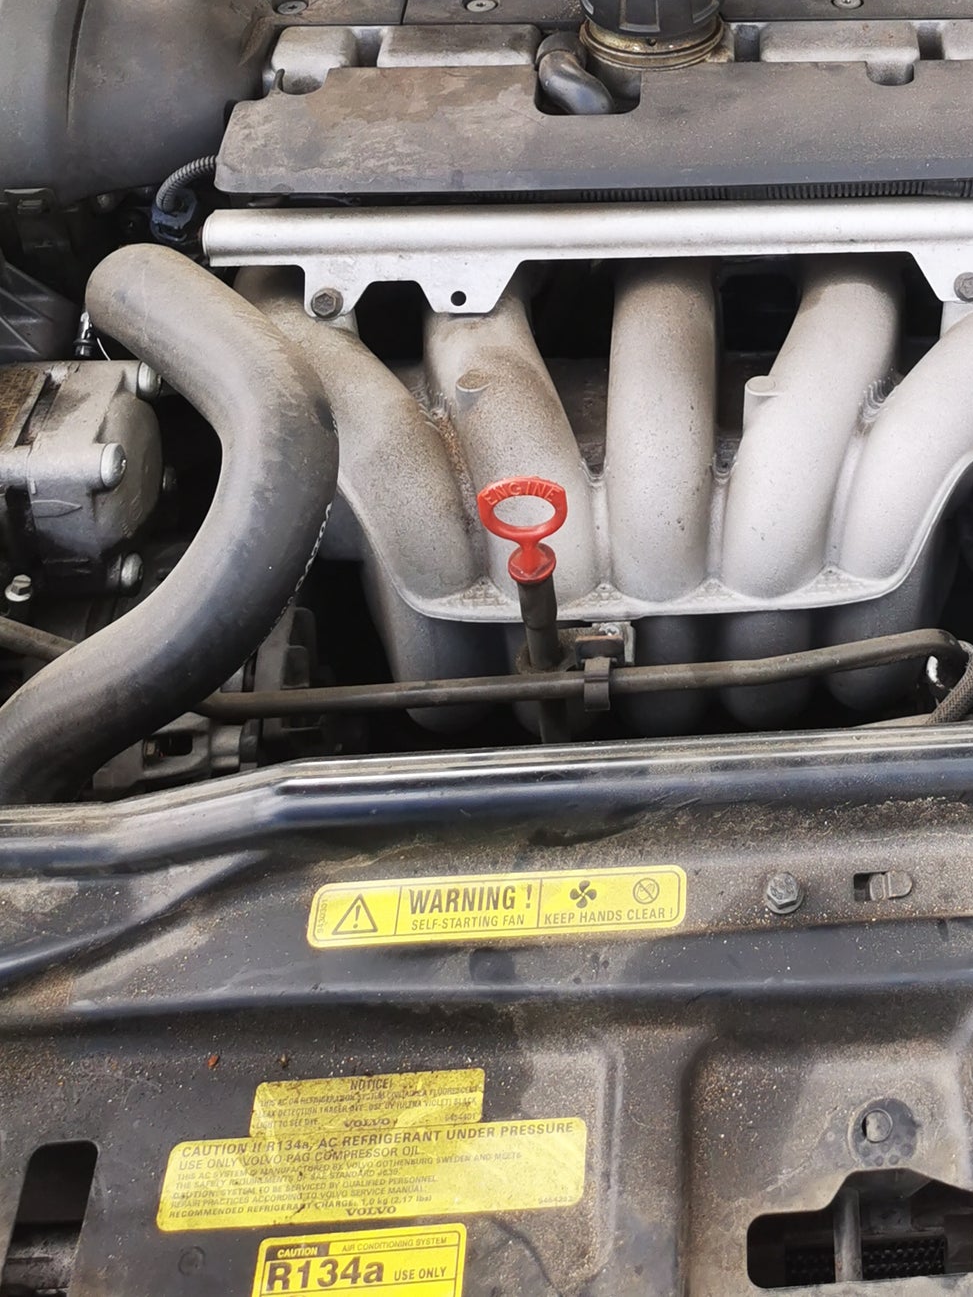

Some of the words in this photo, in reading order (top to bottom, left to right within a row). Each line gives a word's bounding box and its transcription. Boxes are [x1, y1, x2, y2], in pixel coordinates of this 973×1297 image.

[482, 481, 560, 505] ENGINE
[408, 885, 516, 915] WARNING
[412, 914, 498, 932] SELF-STARTING
[502, 914, 525, 926] FAN
[544, 911, 577, 925] KEEP
[579, 909, 624, 923] HANDS
[627, 908, 666, 921] CLEAR
[350, 1078, 393, 1091] NOTICE!
[278, 1107, 318, 1117] DETECTION
[320, 1105, 348, 1114] TRACER
[454, 1097, 478, 1106] BLACK
[278, 1120, 288, 1128] TO
[343, 1118, 390, 1128] VOLVO
[182, 1142, 248, 1158] CAUTION
[317, 1137, 338, 1149] AC
[342, 1130, 442, 1147] REFRIGERANT
[446, 1127, 496, 1141] UNDER
[500, 1122, 574, 1137] PRESSURE
[178, 1160, 204, 1171] USE
[207, 1158, 238, 1168] ONLY
[242, 1154, 282, 1166] VOLVO
[286, 1152, 310, 1163] PAG
[314, 1148, 398, 1162] COMPRESSOR
[197, 1172, 209, 1180] AC
[210, 1170, 247, 1178] SYSTEM
[260, 1164, 330, 1176] MANUFACTURED
[346, 1161, 373, 1170] VOLVO
[376, 1157, 433, 1168] GOTHENBURG
[437, 1155, 470, 1164] SWEDEN
[473, 1154, 491, 1162] AND
[494, 1152, 522, 1161] MEETS
[176, 1182, 192, 1190] THE
[229, 1175, 294, 1186] REQUIREMENTS
[330, 1170, 374, 1179] STANDARD
[220, 1188, 256, 1196] SYSTEM
[258, 1186, 270, 1194] TO
[286, 1182, 326, 1192] SERVICED
[342, 1178, 386, 1188] QUALIFIED
[168, 1207, 244, 1218] RECOMMENDED
[377, 1196, 389, 1206] kg
[170, 1200, 200, 1208] REPAIR
[202, 1196, 249, 1206] PRACTICES
[252, 1193, 302, 1202] ACCORDING
[306, 1192, 317, 1200] TO
[320, 1190, 348, 1198] VOLVO
[350, 1188, 386, 1196] SERVICE
[346, 1206, 396, 1216] VOLVO
[277, 1246, 318, 1259] CAUTION
[342, 1244, 355, 1252] AIR
[356, 1239, 413, 1252] CONDITIONING
[415, 1236, 448, 1246] SYSTEM
[266, 1256, 385, 1292] R134a
[394, 1268, 415, 1281] USE
[418, 1266, 447, 1279] ONLY
